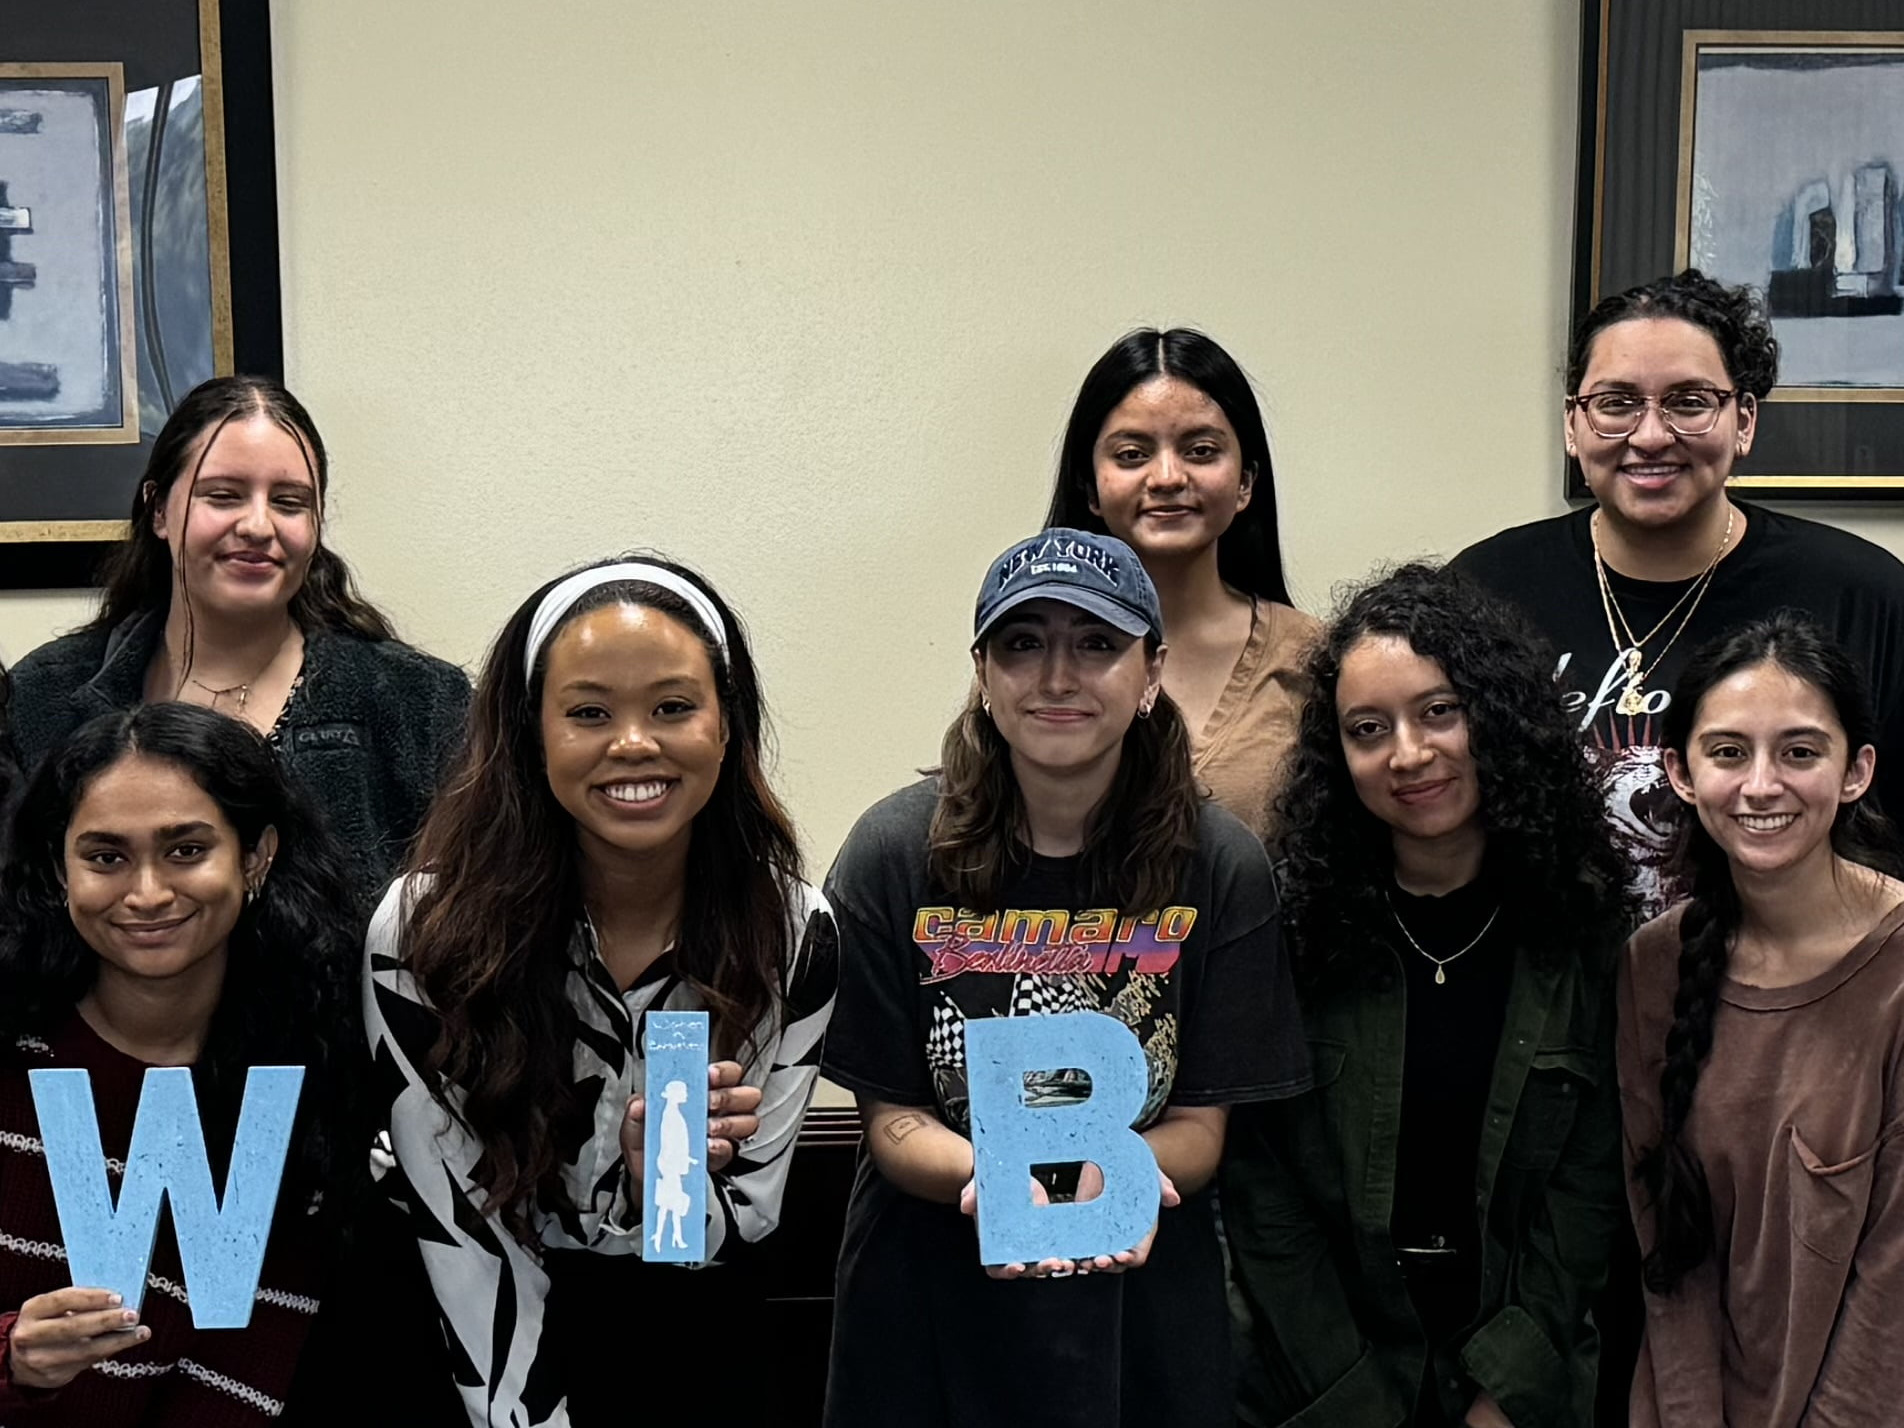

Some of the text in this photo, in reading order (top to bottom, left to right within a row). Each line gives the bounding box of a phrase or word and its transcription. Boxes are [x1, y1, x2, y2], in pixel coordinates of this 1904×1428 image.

[998, 535, 1121, 593] NEW YORK
[27, 1065, 306, 1329] W
[963, 1012, 1163, 1266] B
